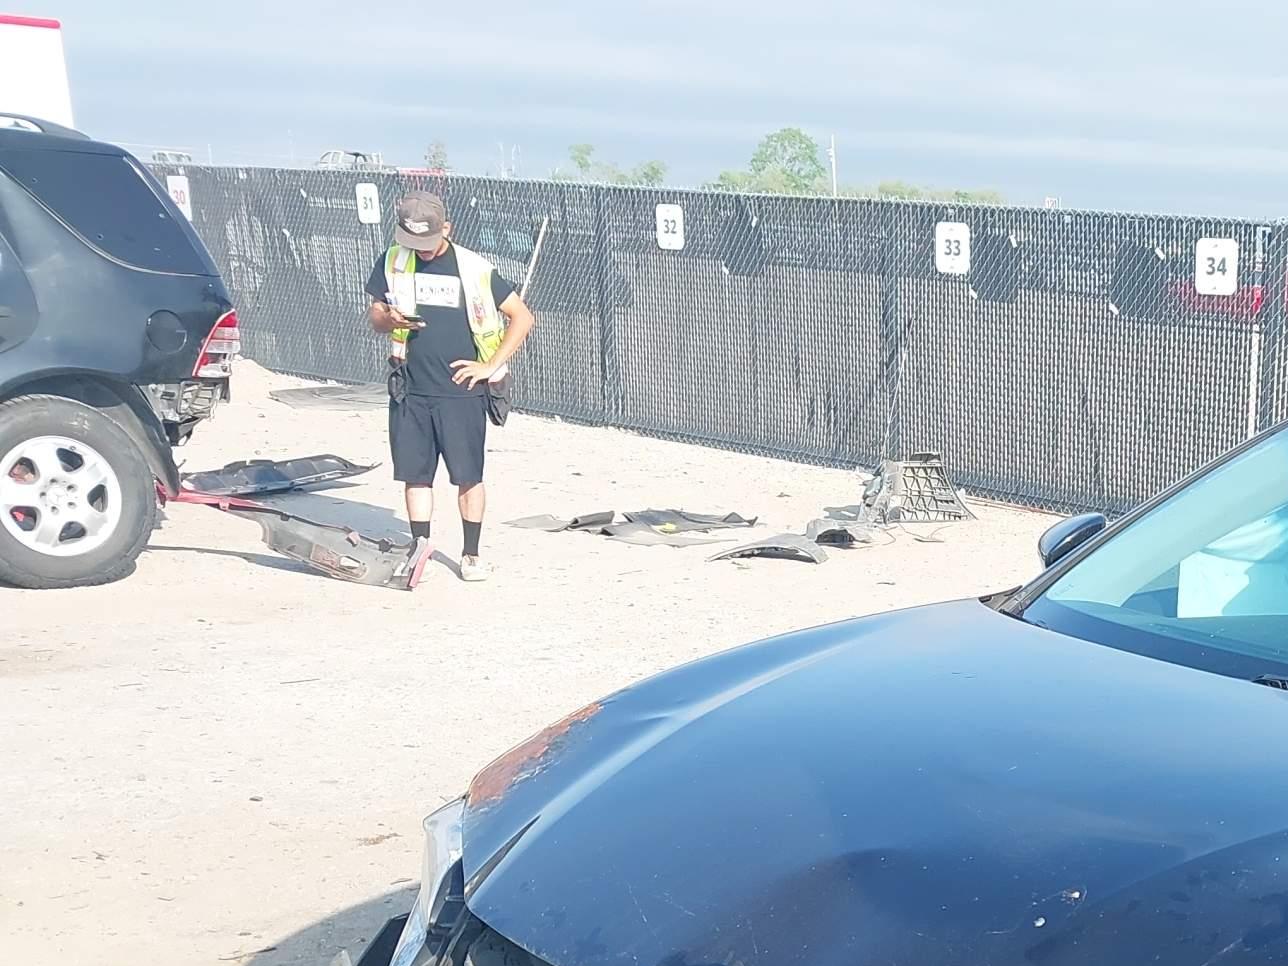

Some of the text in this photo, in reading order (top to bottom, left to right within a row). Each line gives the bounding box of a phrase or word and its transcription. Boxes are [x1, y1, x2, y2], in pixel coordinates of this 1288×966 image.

[362, 196, 374, 210] 31
[663, 218, 678, 235] 32
[944, 239, 961, 257] 33
[1205, 256, 1228, 276] 34
